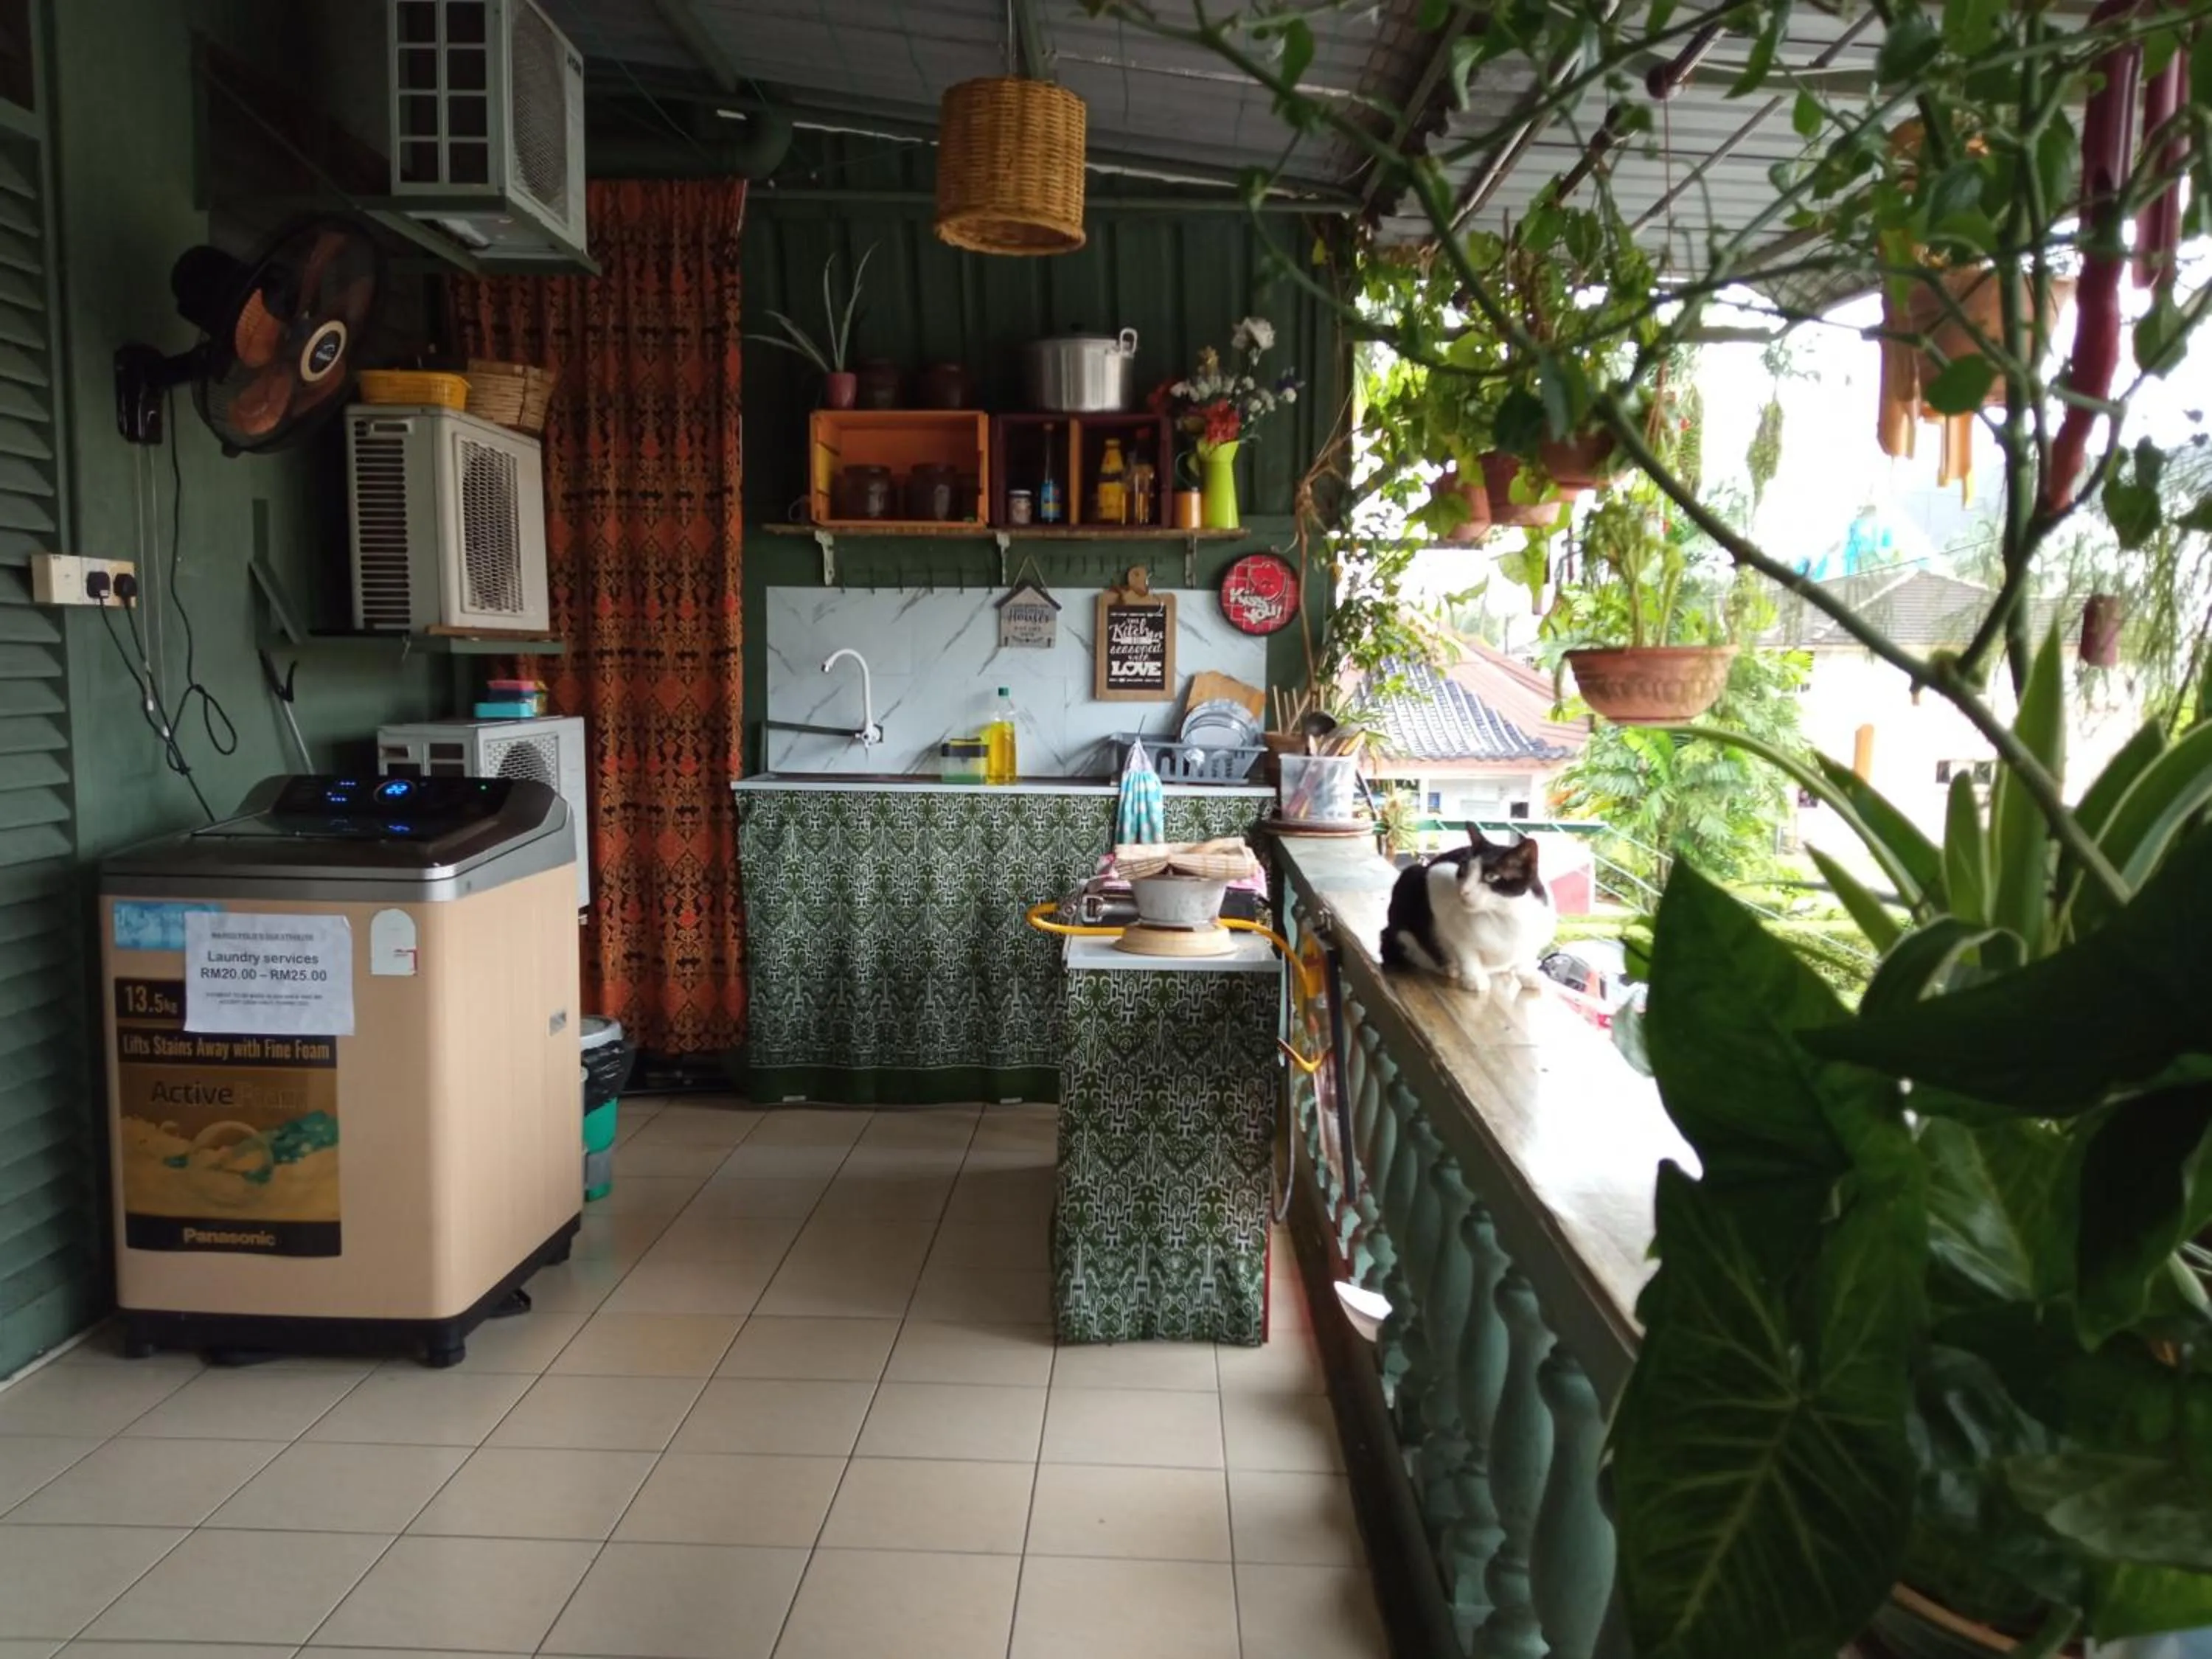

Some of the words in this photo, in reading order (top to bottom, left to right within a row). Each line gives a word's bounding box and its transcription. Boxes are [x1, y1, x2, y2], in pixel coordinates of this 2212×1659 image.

[1111, 661, 1161, 676] LOVE
[207, 950, 260, 965] Laundry
[263, 952, 319, 964] services
[201, 967, 257, 981] RM20.00
[270, 969, 327, 982] RM25.00
[122, 1034, 150, 1055] Lifts
[153, 1035, 192, 1057] Stains
[197, 1037, 229, 1060] Away
[233, 1038, 260, 1058] with
[265, 1039, 291, 1059] Fine
[295, 1040, 330, 1060] Foam
[183, 1227, 276, 1246] Panasonic
